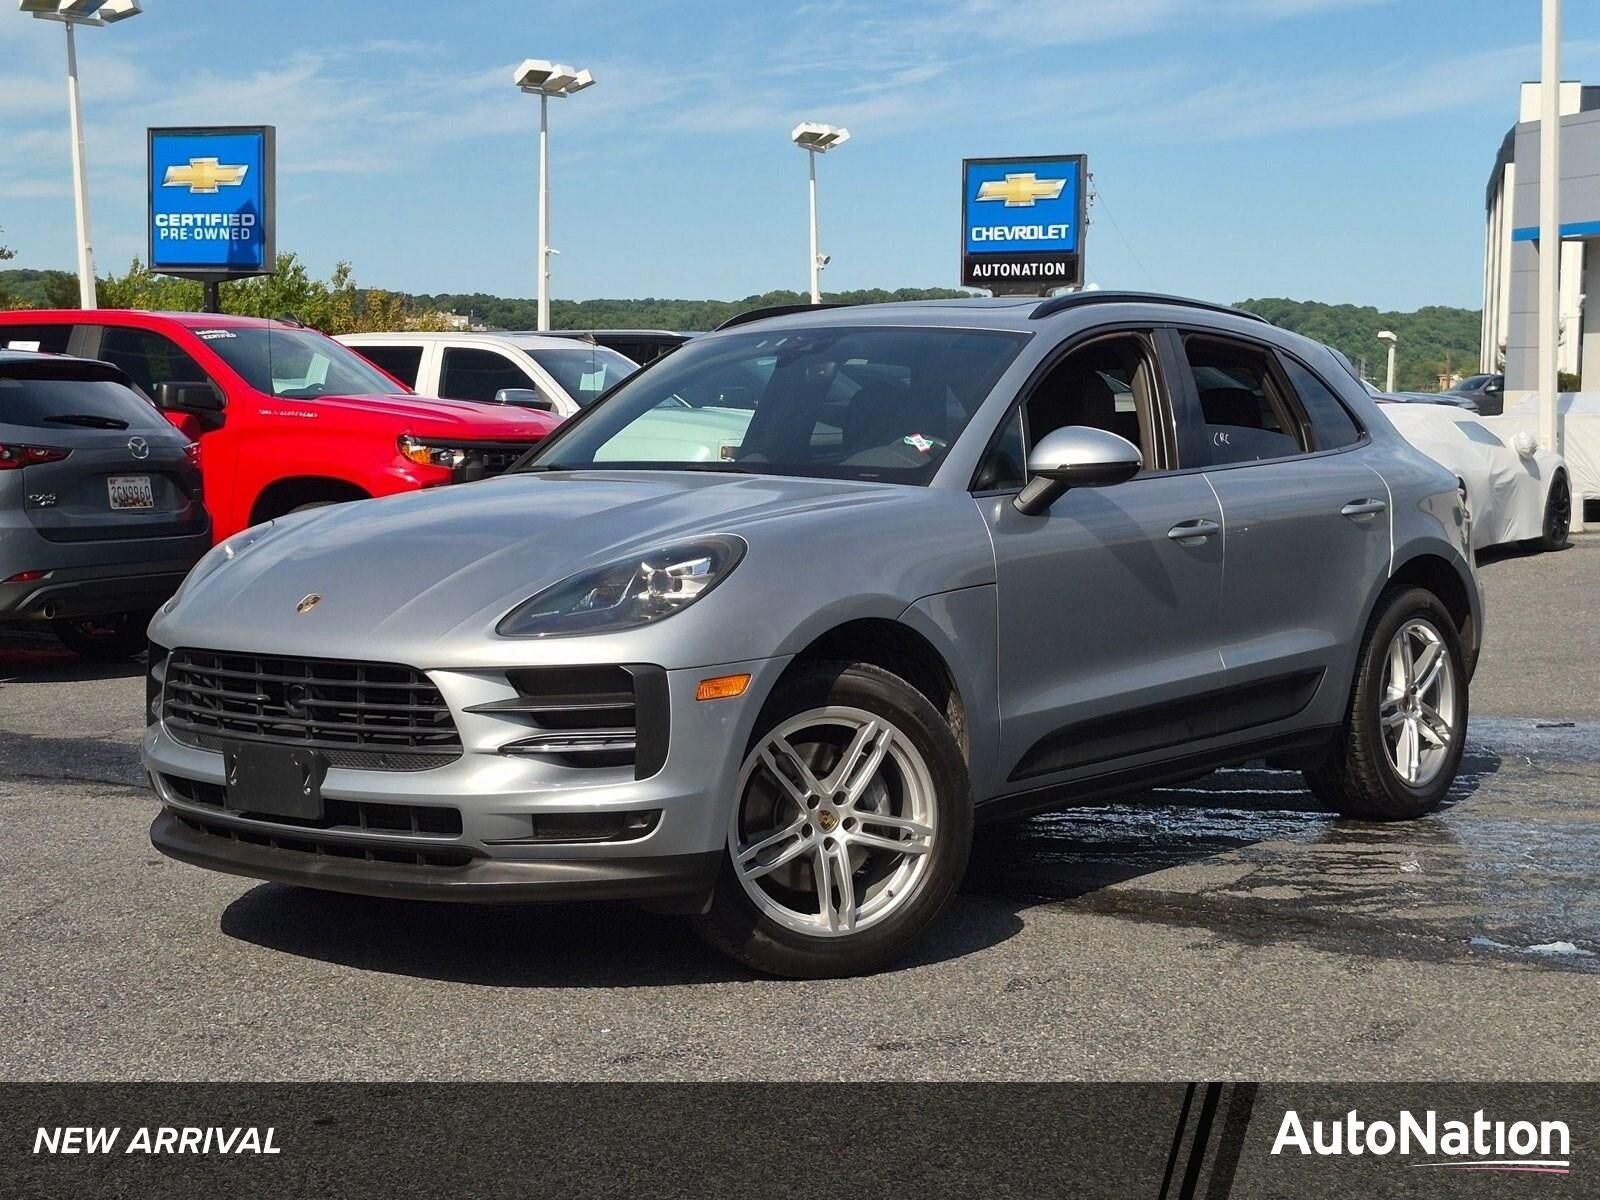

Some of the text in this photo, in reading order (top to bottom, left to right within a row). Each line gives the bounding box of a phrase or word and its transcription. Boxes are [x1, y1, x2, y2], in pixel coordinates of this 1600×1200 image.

[155, 213, 256, 227] CERTIFIED
[160, 228, 250, 241] PRE-OWNED
[972, 225, 1069, 241] CHEVROLET
[972, 262, 1066, 277] AUTONATION
